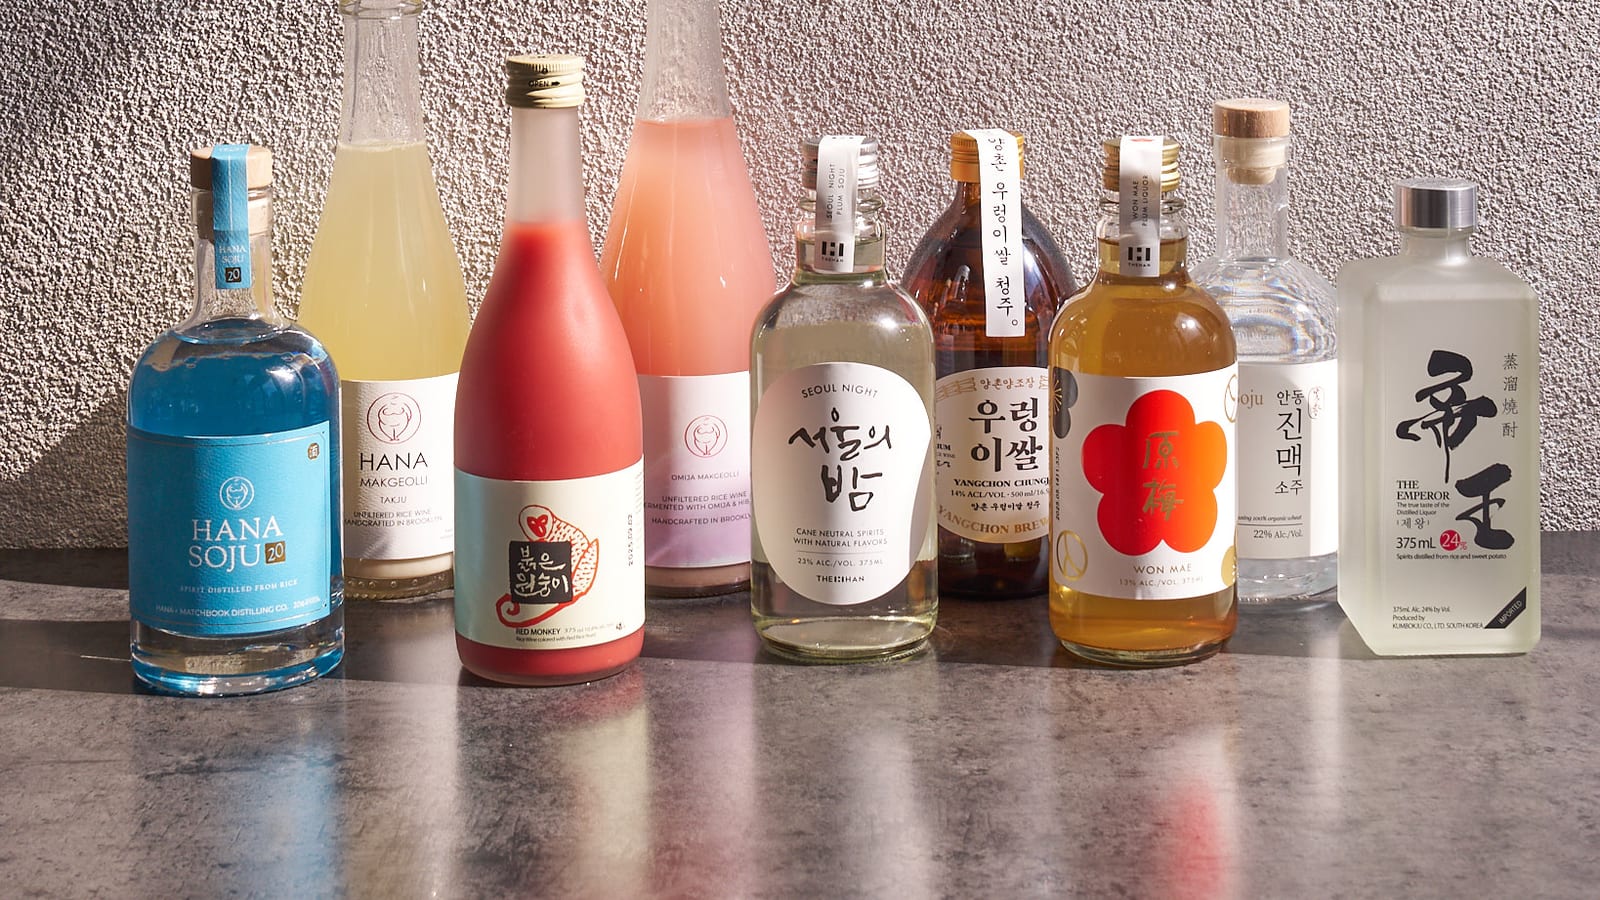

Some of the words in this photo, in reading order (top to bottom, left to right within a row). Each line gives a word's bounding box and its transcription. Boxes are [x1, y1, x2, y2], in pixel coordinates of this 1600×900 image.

[992, 182, 1011, 266] 우렁이쌀
[219, 245, 247, 254] HANA
[222, 254, 244, 264] SOJU
[226, 268, 240, 282] 20
[801, 384, 837, 398] SEOUL
[842, 384, 878, 398] NIGHT
[1276, 390, 1304, 406] 안동
[1238, 389, 1264, 409] oju
[968, 397, 1038, 434] 우렁
[788, 407, 892, 461] 서울의
[1276, 408, 1302, 476] 진맥
[970, 436, 1043, 472] 이쌀
[360, 452, 428, 471] HANA
[359, 476, 428, 488] MAKGEOLLI
[698, 471, 740, 480] MAKGEOLLI
[954, 478, 1011, 487] YANGCHON
[821, 465, 883, 512] 밤
[1274, 480, 1304, 495] 소주
[1396, 480, 1420, 489] THE
[662, 495, 710, 503] UNFILTERED
[730, 491, 748, 500] WINE
[951, 490, 966, 498] 14%
[968, 490, 1006, 498] ACL/VOL
[1397, 491, 1450, 500] EMPEROR
[686, 502, 706, 510] WITH
[708, 501, 731, 510] OMIJA
[354, 510, 394, 519] UNFILTERED
[396, 510, 412, 518] RICE
[652, 517, 709, 526] HANDCRAFTED
[938, 504, 1010, 534] YANGCHON
[192, 515, 284, 542] HANA
[796, 528, 816, 537] CANE
[819, 530, 854, 538] NEUTRAL
[856, 528, 884, 537] SPIRITS
[1254, 530, 1272, 538] 22%
[794, 538, 812, 546] WITH
[815, 540, 850, 548] NATURAL
[854, 538, 888, 547] FLAVORS
[188, 544, 260, 572] SOJU
[266, 542, 286, 563] 20
[518, 545, 566, 572] 붉은
[798, 557, 814, 566] 23%
[816, 558, 855, 568] ALC./VOL.
[1133, 565, 1164, 574] WON
[1169, 563, 1192, 573] MAE
[180, 585, 204, 594] SPIRIT
[208, 584, 252, 594] DISTILLED
[254, 582, 278, 592] FROM
[279, 579, 298, 588] RICE
[514, 572, 569, 597] 원숭이
[1120, 578, 1136, 586] 13%
[180, 608, 230, 617] MATCHBOOK
[232, 606, 274, 616] DISTILLING
[276, 603, 288, 613] CO.
[1498, 600, 1523, 624] IMPORTED
[530, 628, 560, 636] MONKEY
